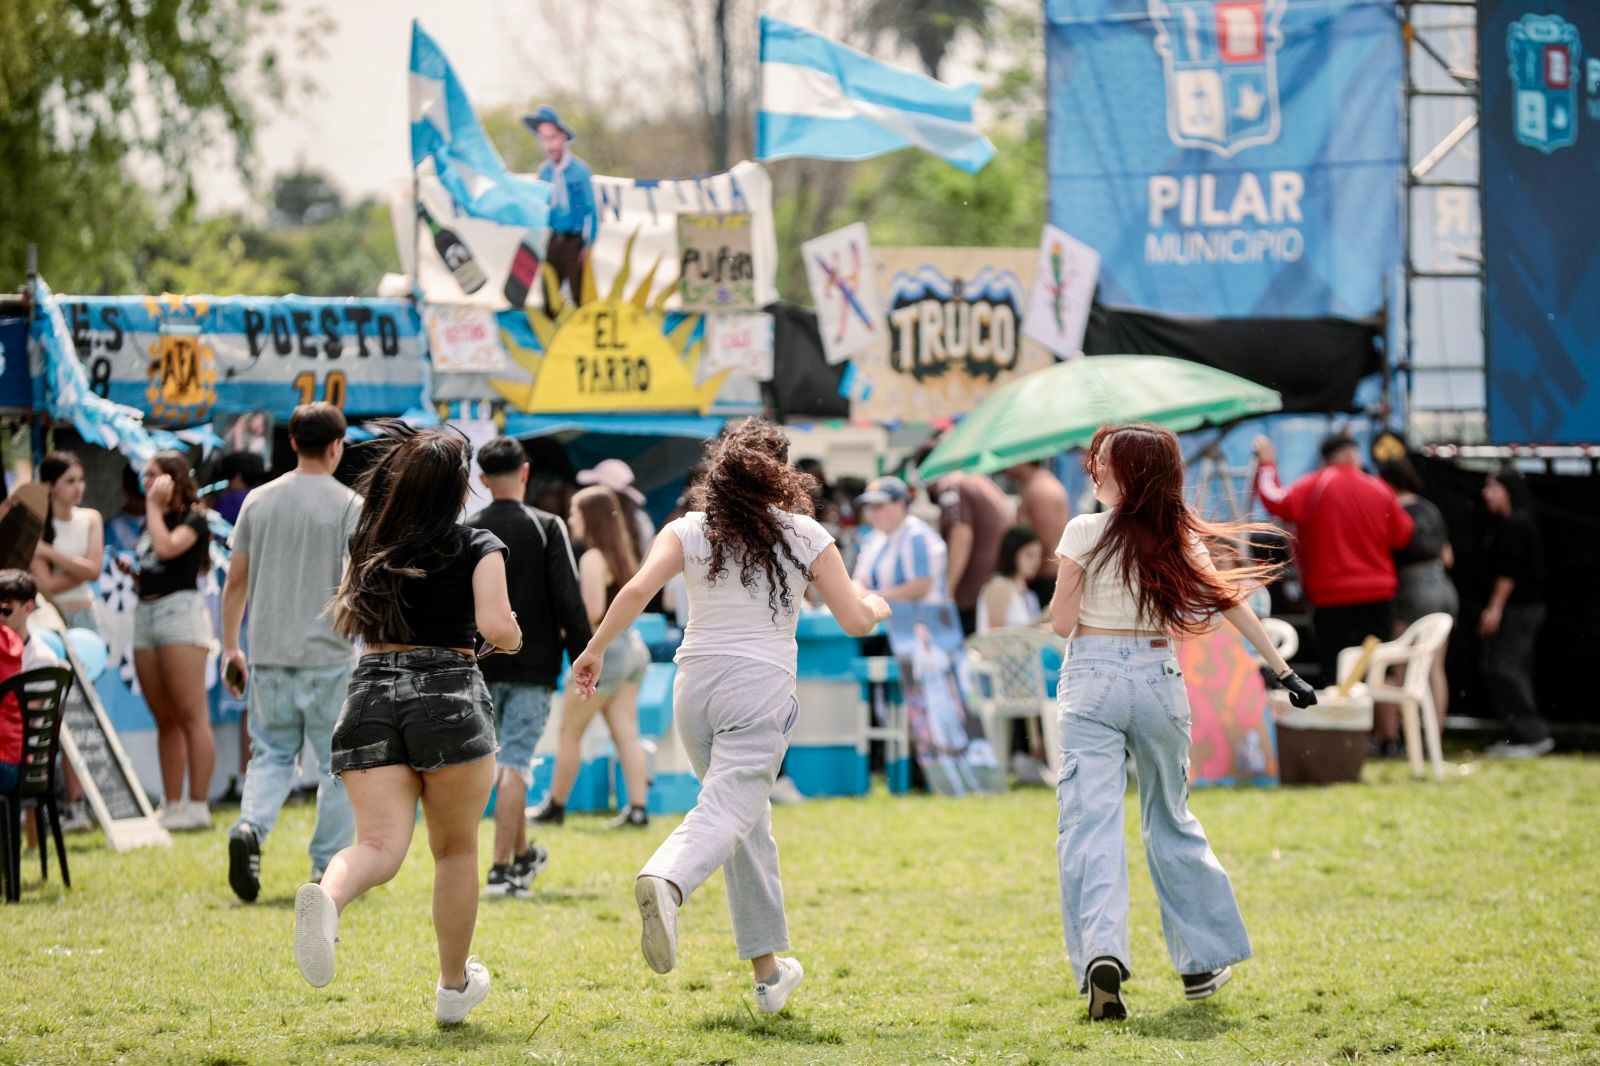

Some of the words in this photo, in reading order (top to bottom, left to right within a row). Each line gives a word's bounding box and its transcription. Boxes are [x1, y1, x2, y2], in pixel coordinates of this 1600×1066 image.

[1148, 170, 1305, 227] PILAR
[1144, 226, 1304, 266] MUNICIPIO
[244, 305, 399, 360] PUESTO
[594, 312, 626, 349] EL
[891, 299, 1016, 370] TRUCO
[293, 369, 346, 410] 10
